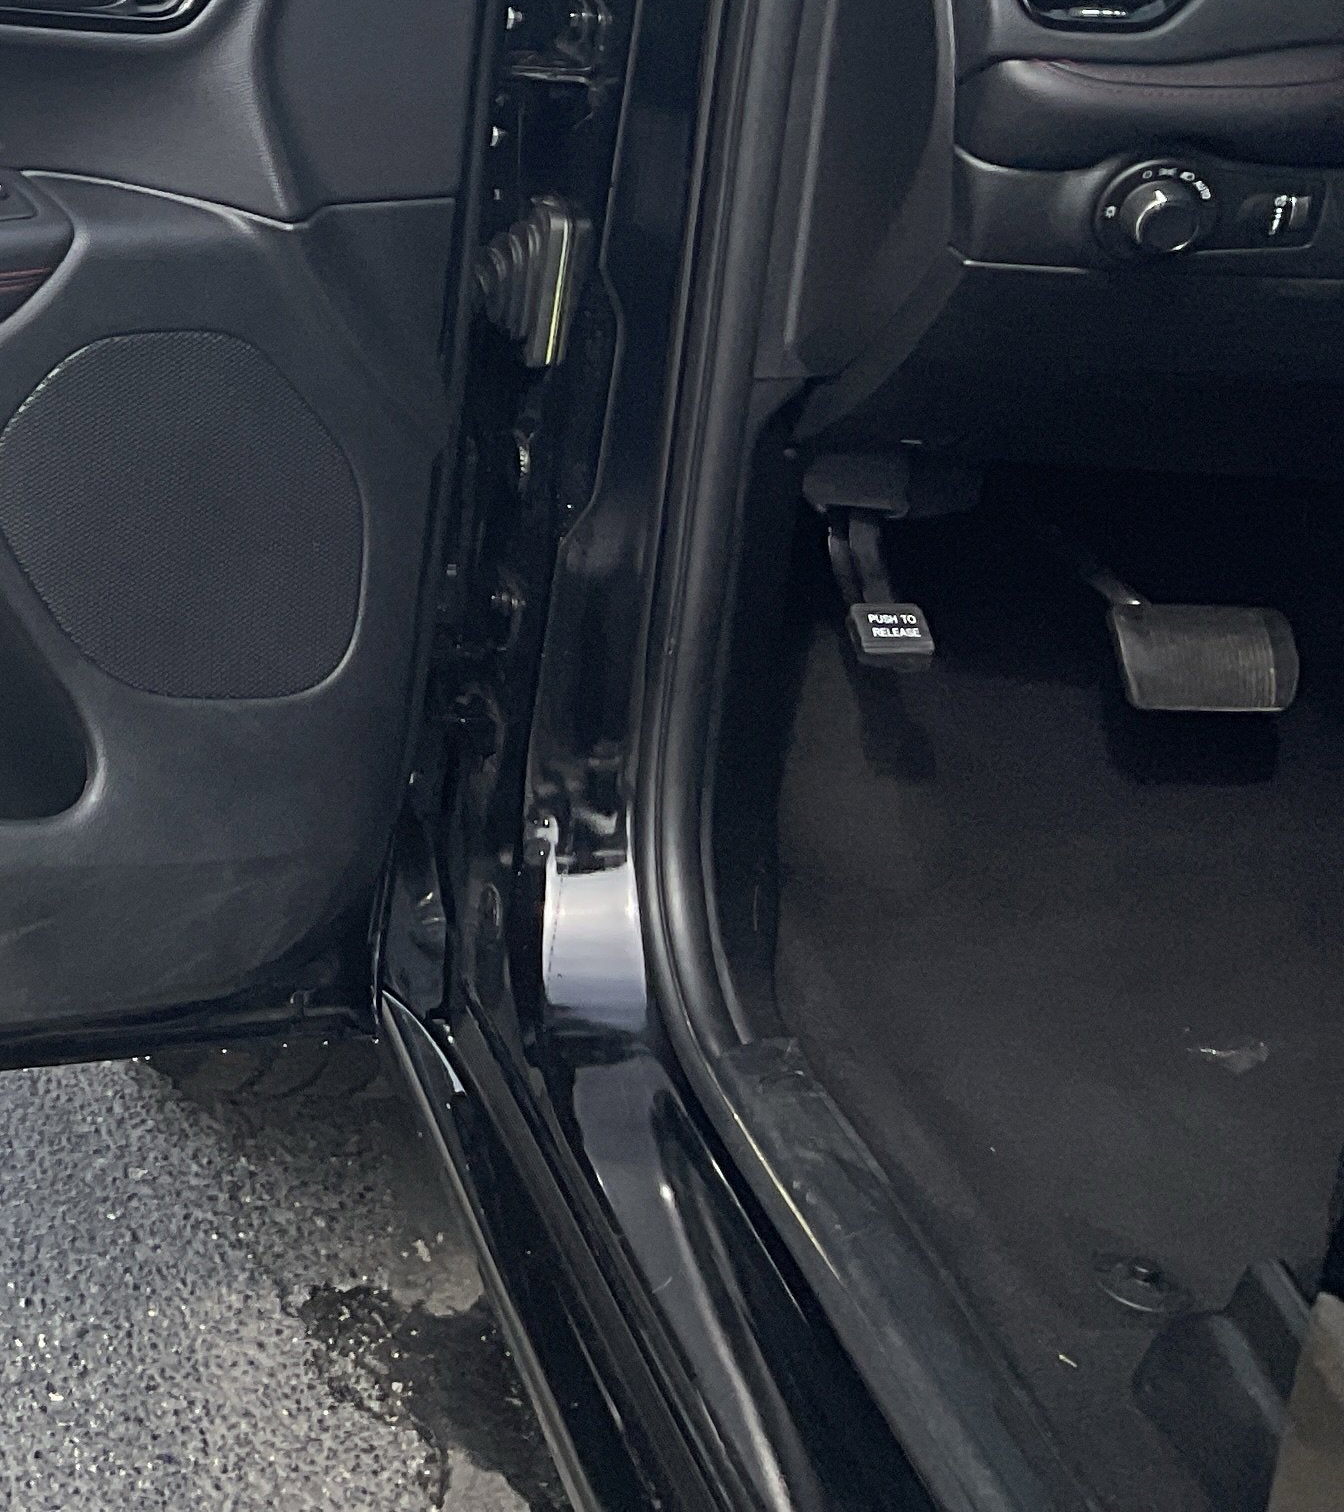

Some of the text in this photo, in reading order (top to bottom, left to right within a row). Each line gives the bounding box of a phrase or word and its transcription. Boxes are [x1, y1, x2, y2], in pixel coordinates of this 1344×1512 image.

[867, 613, 917, 624] PUSH TO
[872, 627, 922, 637] RELEASE
